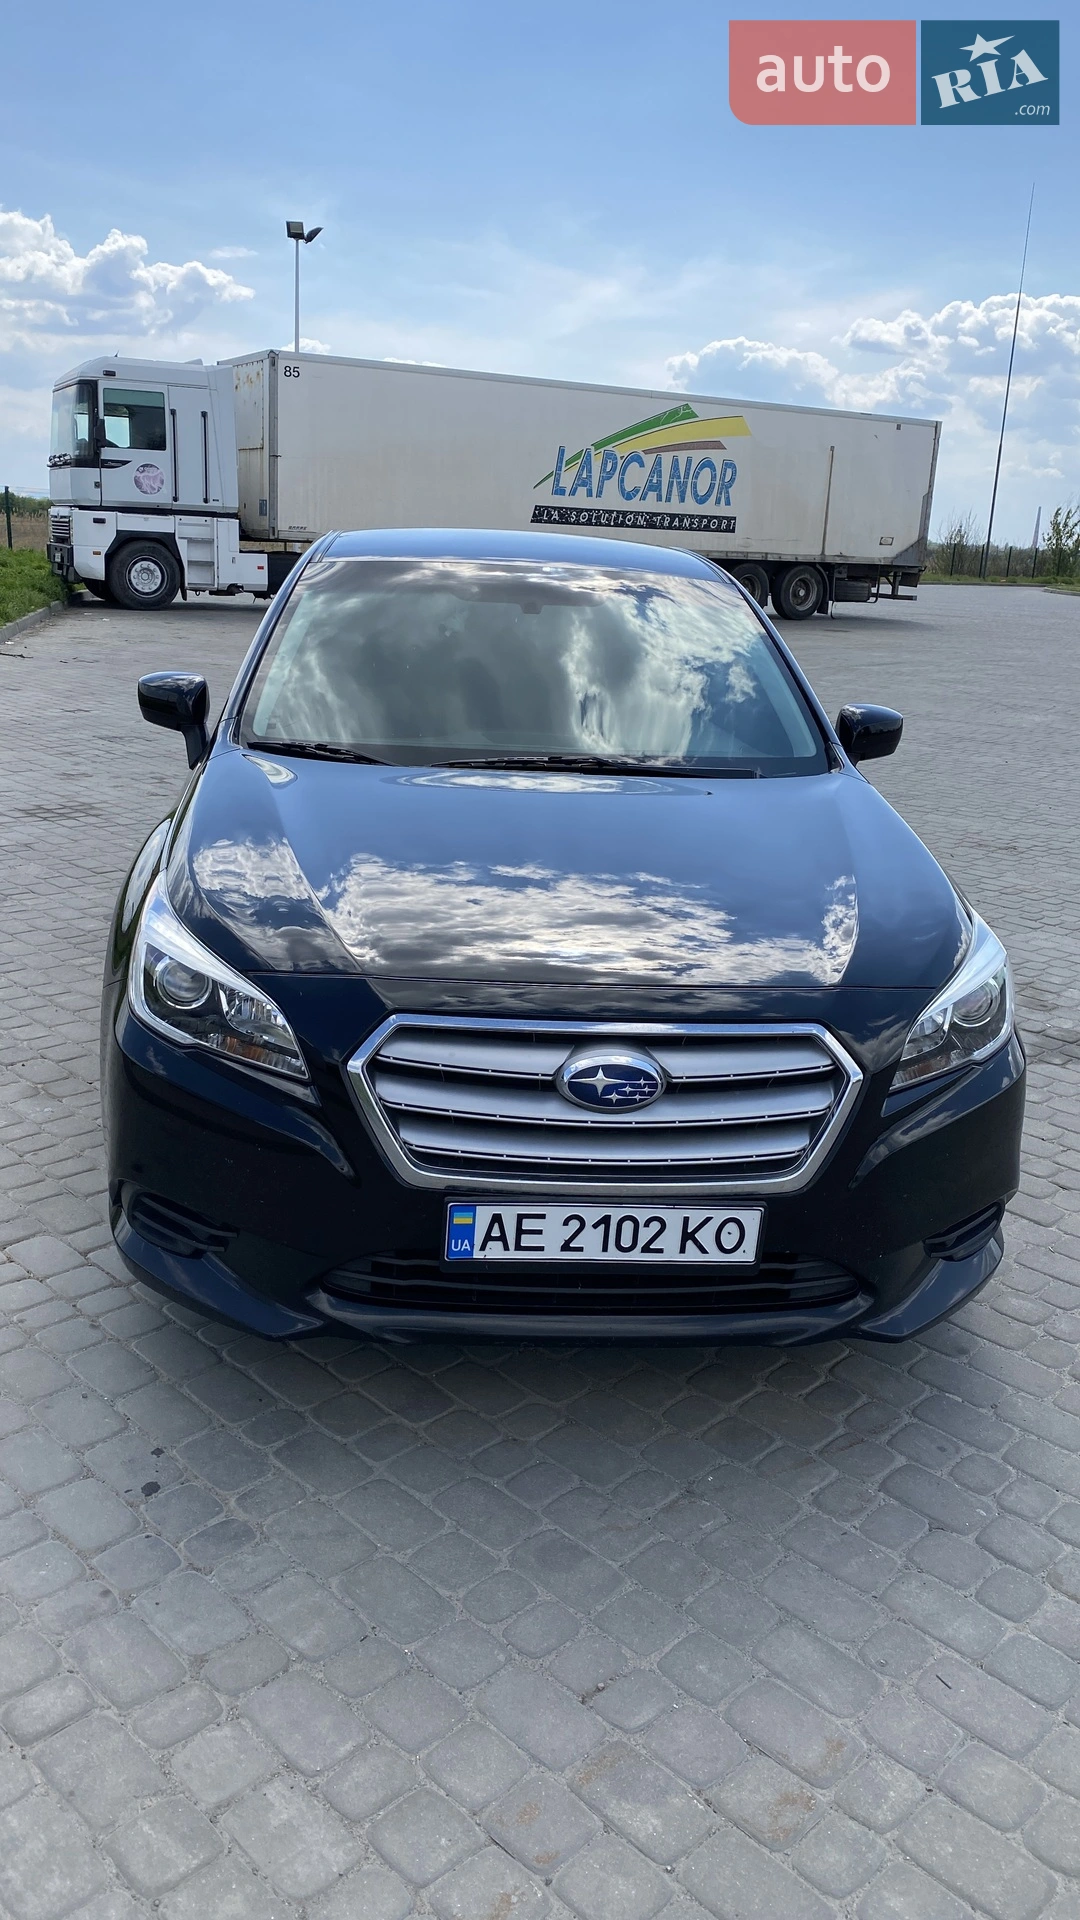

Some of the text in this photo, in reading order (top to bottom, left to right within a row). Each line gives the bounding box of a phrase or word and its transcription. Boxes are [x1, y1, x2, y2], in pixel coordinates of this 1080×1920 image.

[284, 366, 300, 378] 85
[551, 446, 737, 507] LAPCANOR
[543, 510, 736, 531] LA SOLUTION TRANSPORT
[479, 1212, 746, 1255] AE 2102 KO
[451, 1239, 471, 1252] UA
